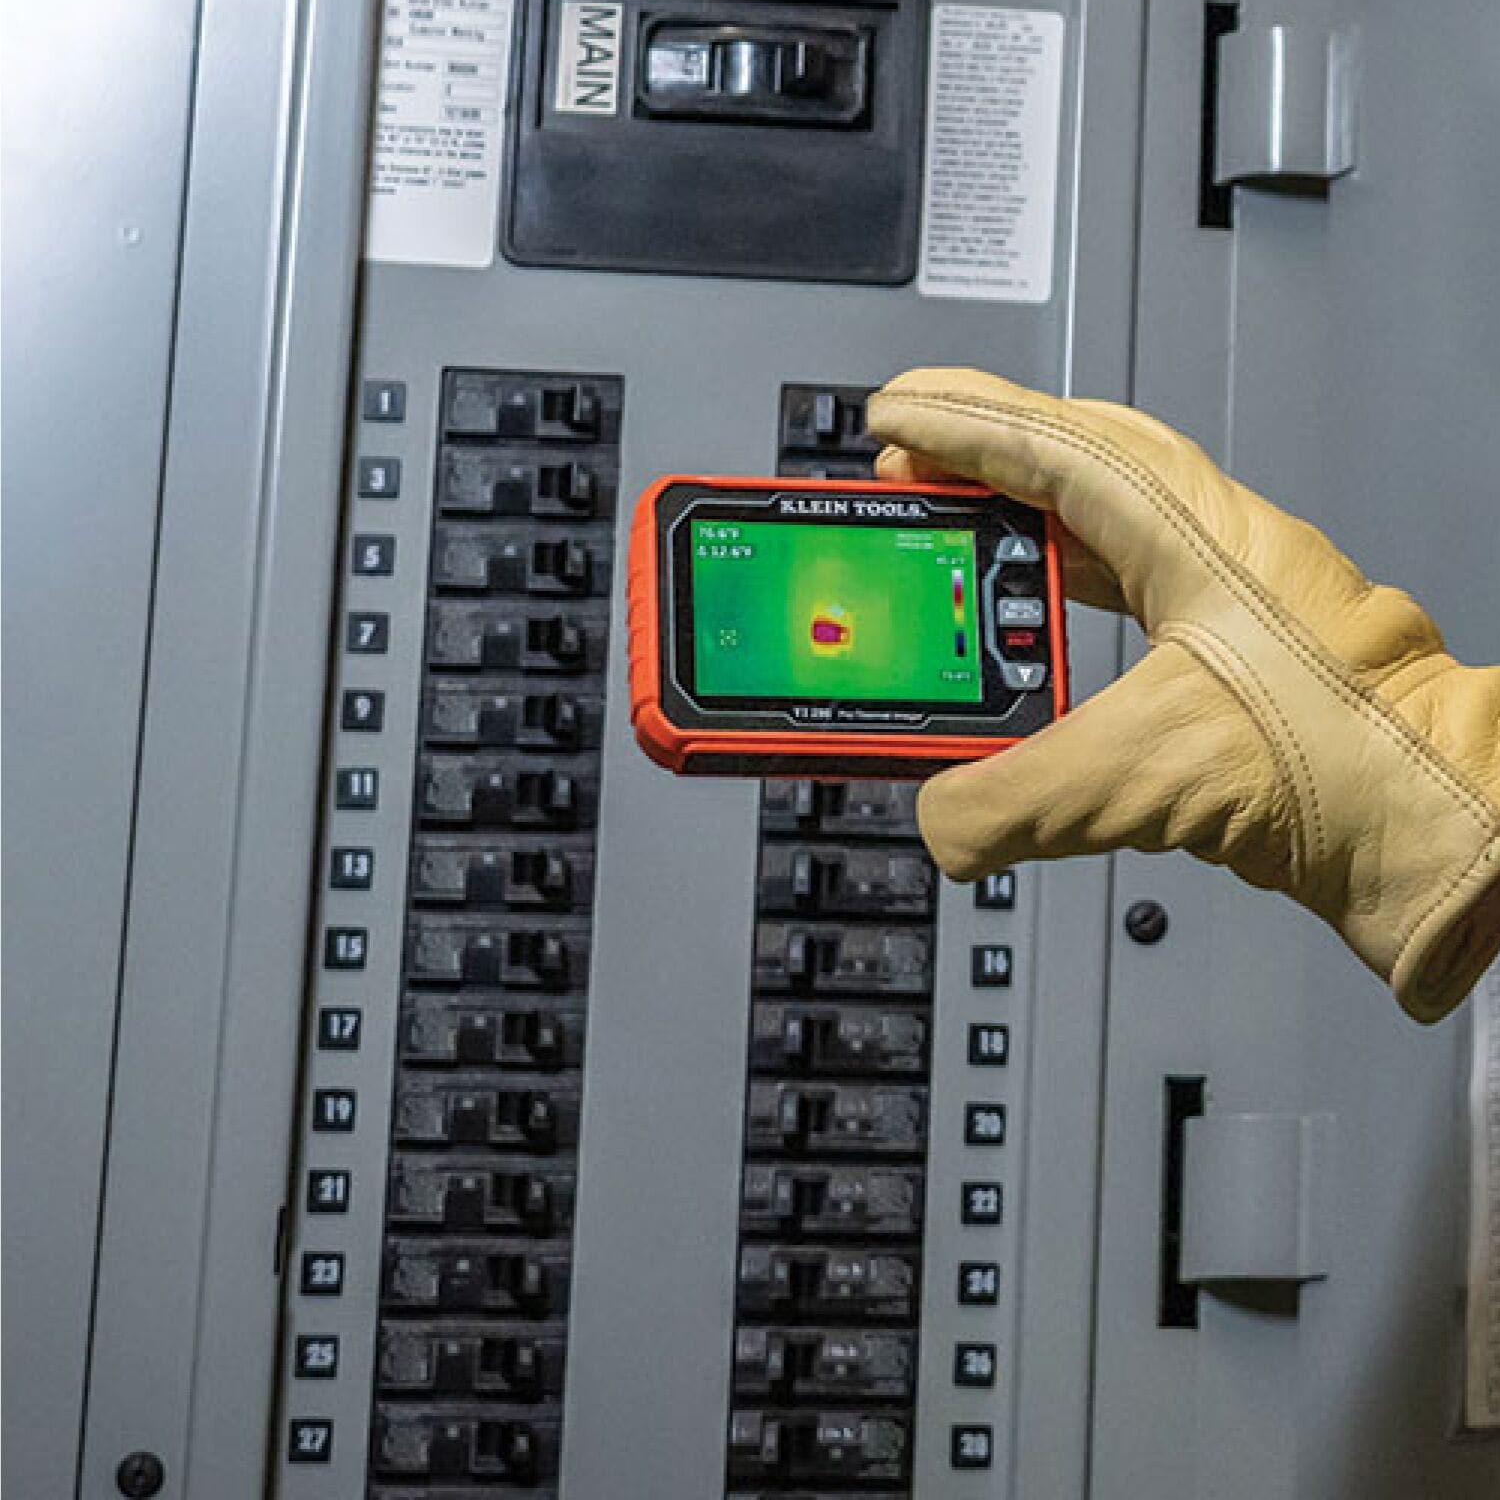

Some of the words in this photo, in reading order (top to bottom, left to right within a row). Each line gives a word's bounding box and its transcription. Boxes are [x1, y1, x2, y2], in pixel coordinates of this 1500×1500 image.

[576, 5, 617, 107] MAIN
[370, 467, 386, 490] 3
[779, 500, 848, 516] KLEIN
[853, 501, 922, 518] TOOLS
[364, 546, 379, 567] 5
[361, 624, 373, 645] 7
[355, 696, 371, 720] 9
[352, 774, 372, 795] 11
[345, 855, 367, 876] 13
[338, 936, 361, 957] 15
[331, 1014, 356, 1038] 17
[327, 1098, 350, 1122] 19
